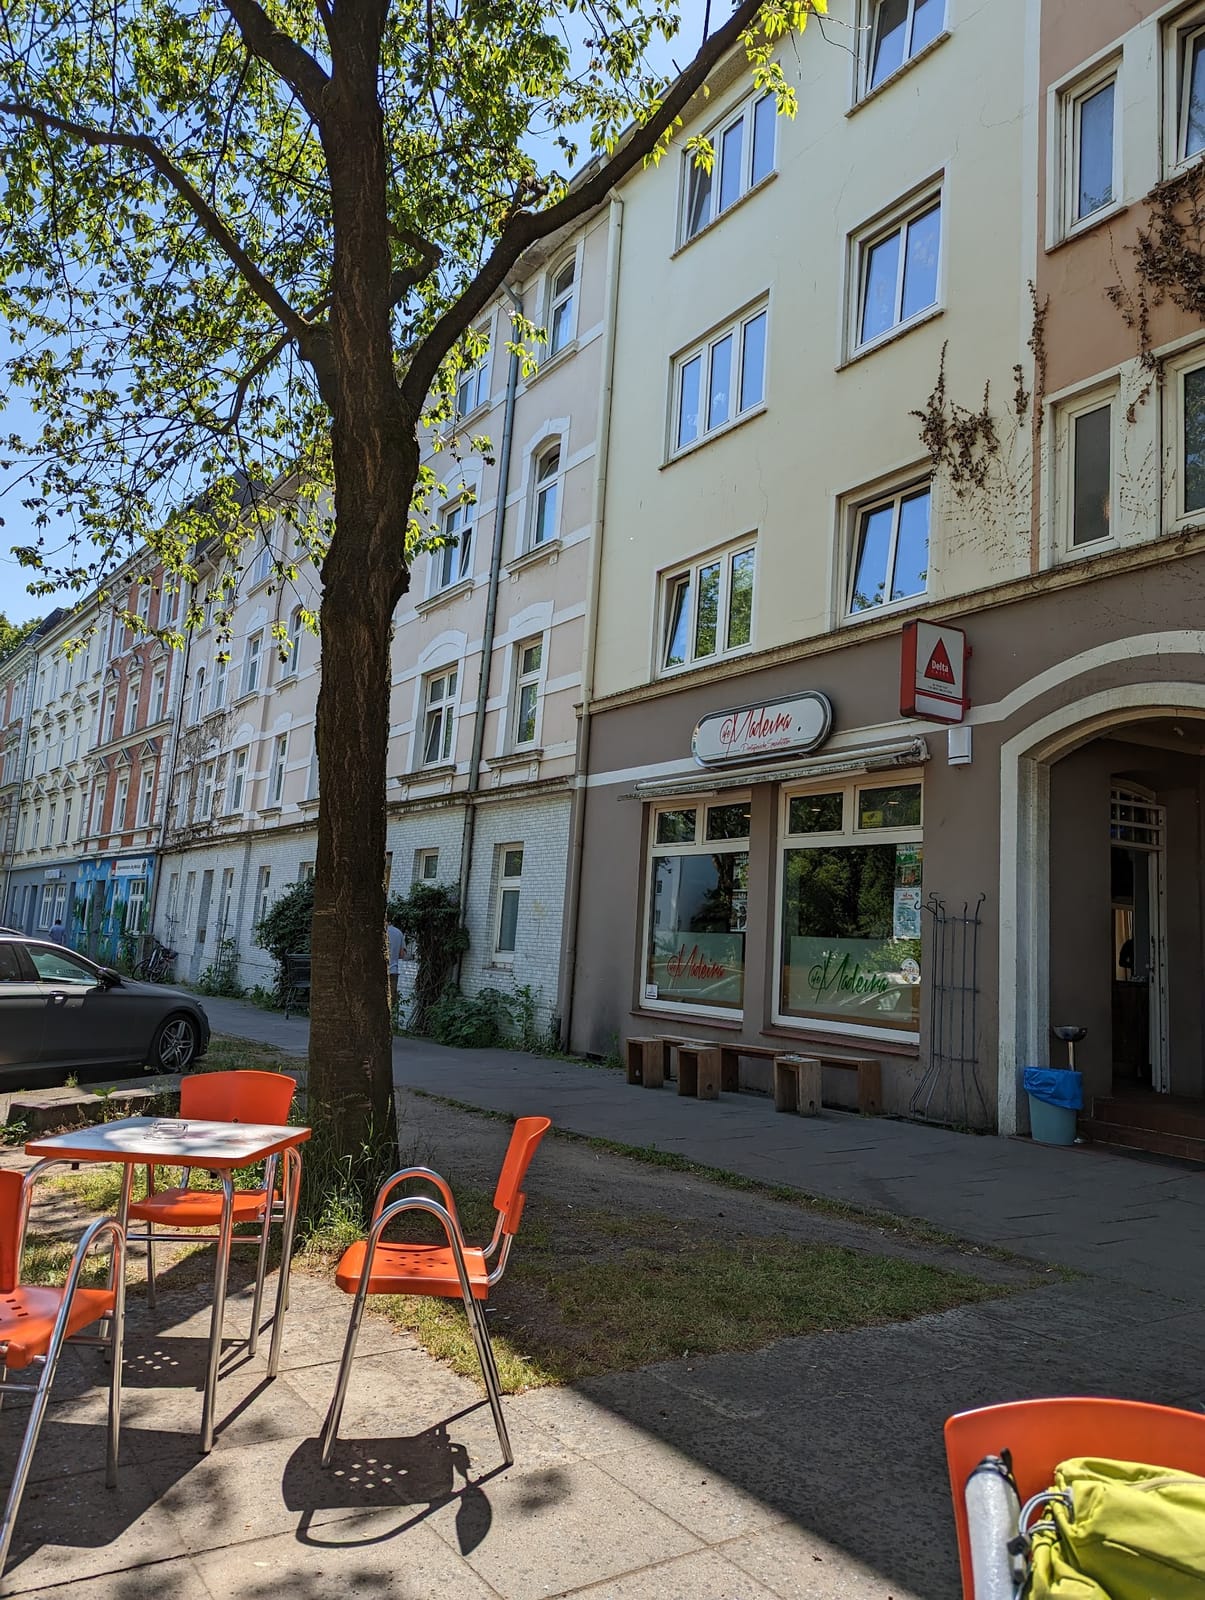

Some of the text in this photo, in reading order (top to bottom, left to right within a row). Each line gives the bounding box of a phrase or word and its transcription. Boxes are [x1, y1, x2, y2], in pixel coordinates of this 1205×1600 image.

[931, 659, 949, 673] Delta
[725, 707, 793, 760] Madeira
[672, 943, 726, 989] Madeira
[815, 949, 889, 1004] Madeira
